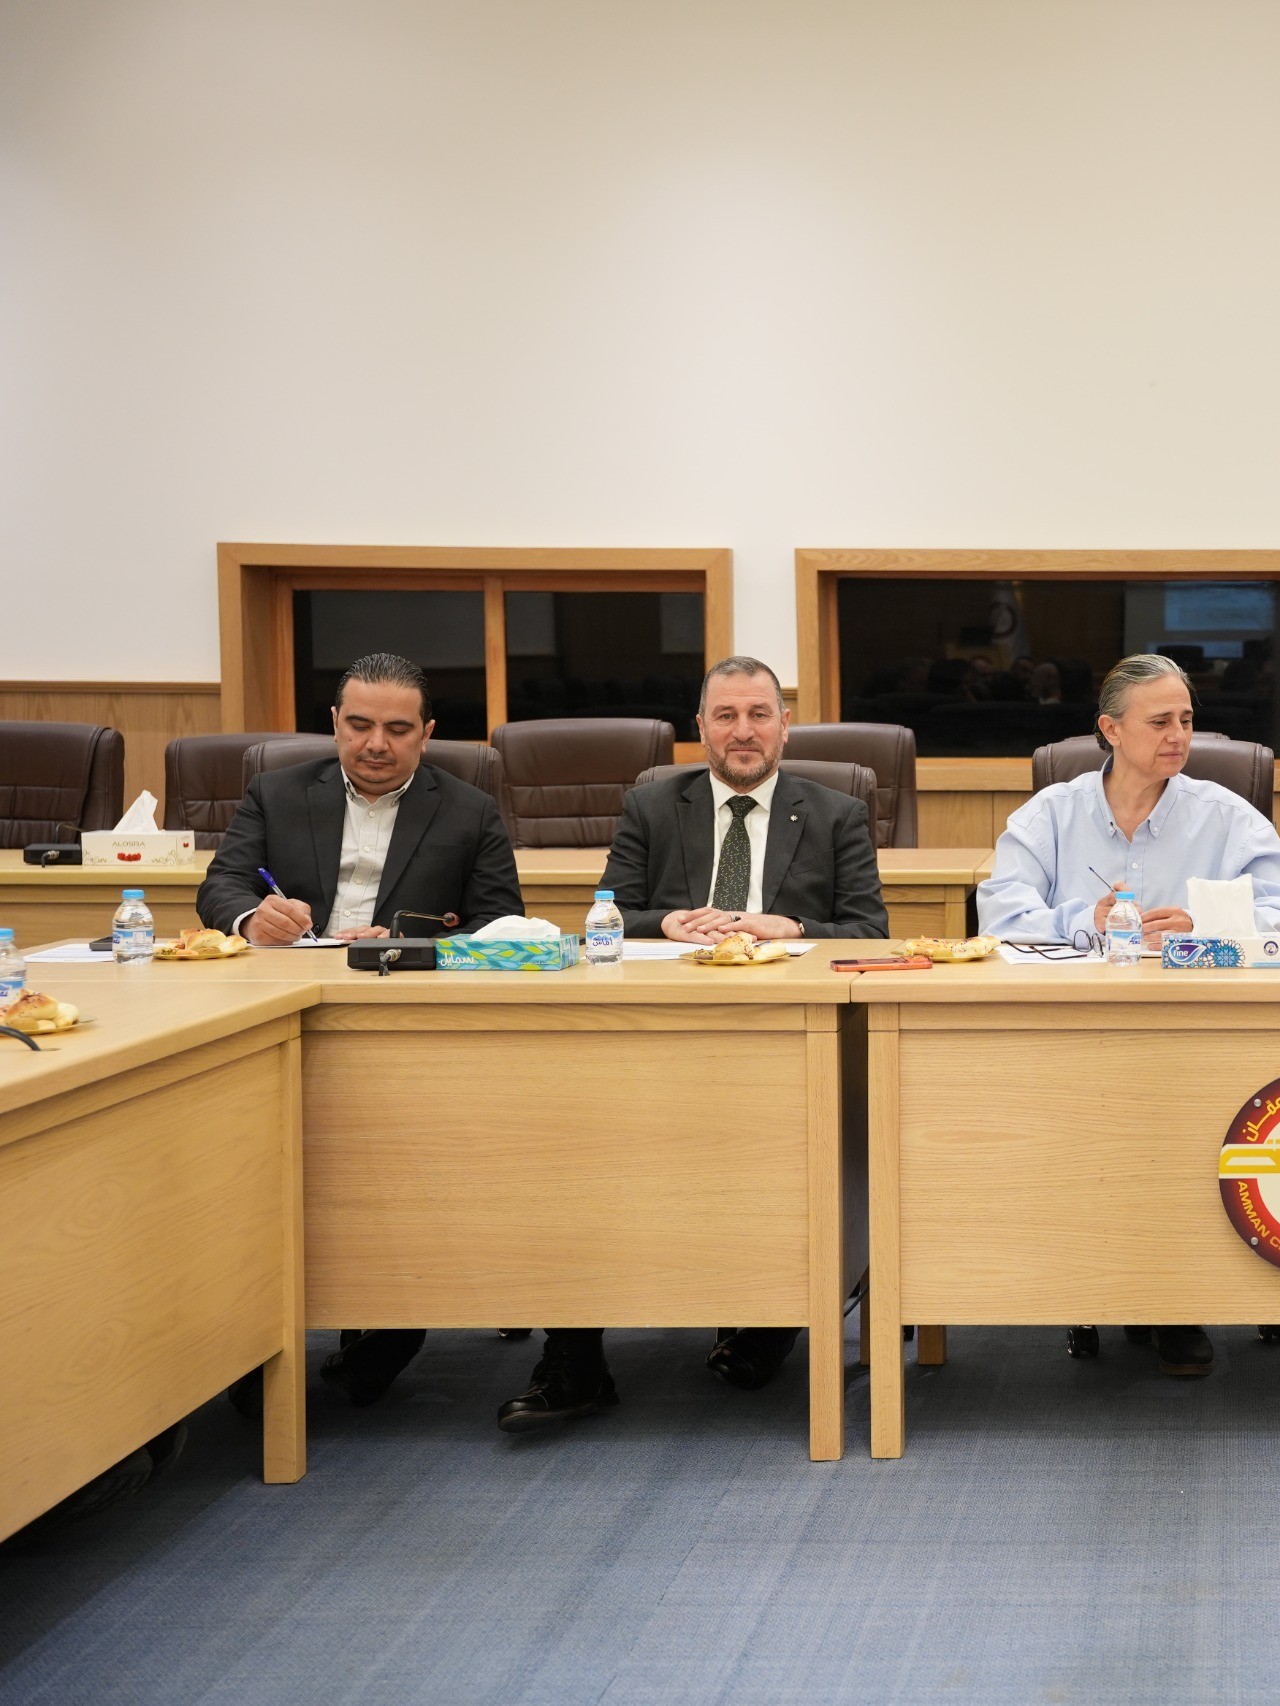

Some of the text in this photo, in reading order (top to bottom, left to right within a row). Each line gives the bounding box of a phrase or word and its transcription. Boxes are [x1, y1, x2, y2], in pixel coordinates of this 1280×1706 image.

[1173, 946, 1188, 957] fine
[439, 952, 474, 966] سمايل
[1237, 1181, 1270, 1238] AMMAN
